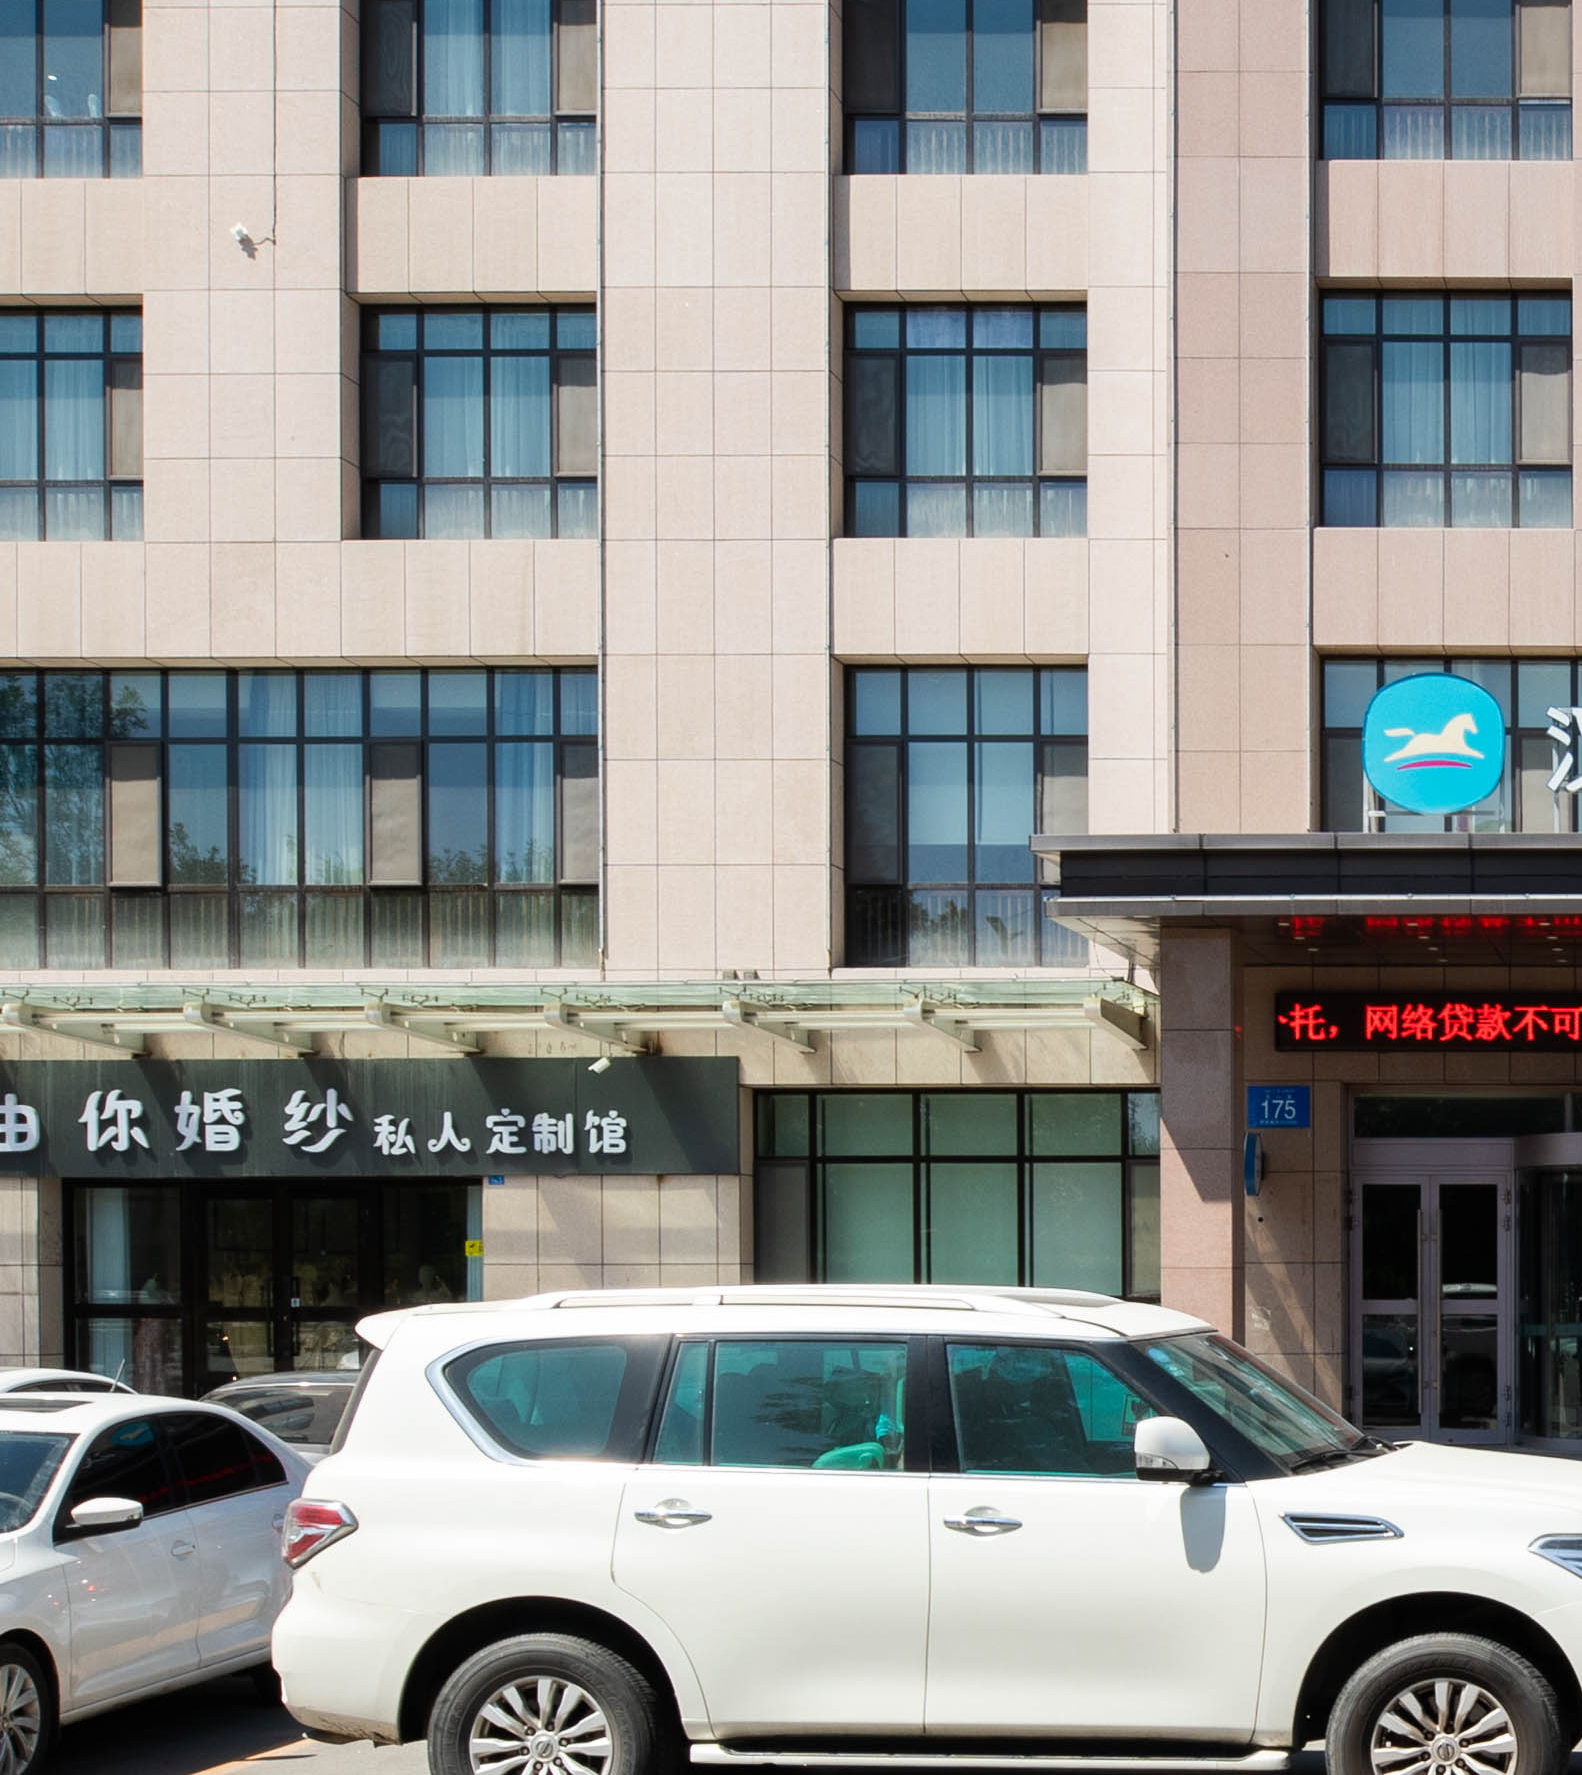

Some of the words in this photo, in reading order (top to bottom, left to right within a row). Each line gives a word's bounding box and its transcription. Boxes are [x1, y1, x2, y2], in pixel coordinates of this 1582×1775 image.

[1261, 1099, 1297, 1120] 175
[373, 1108, 627, 1156] 私人定制馆
